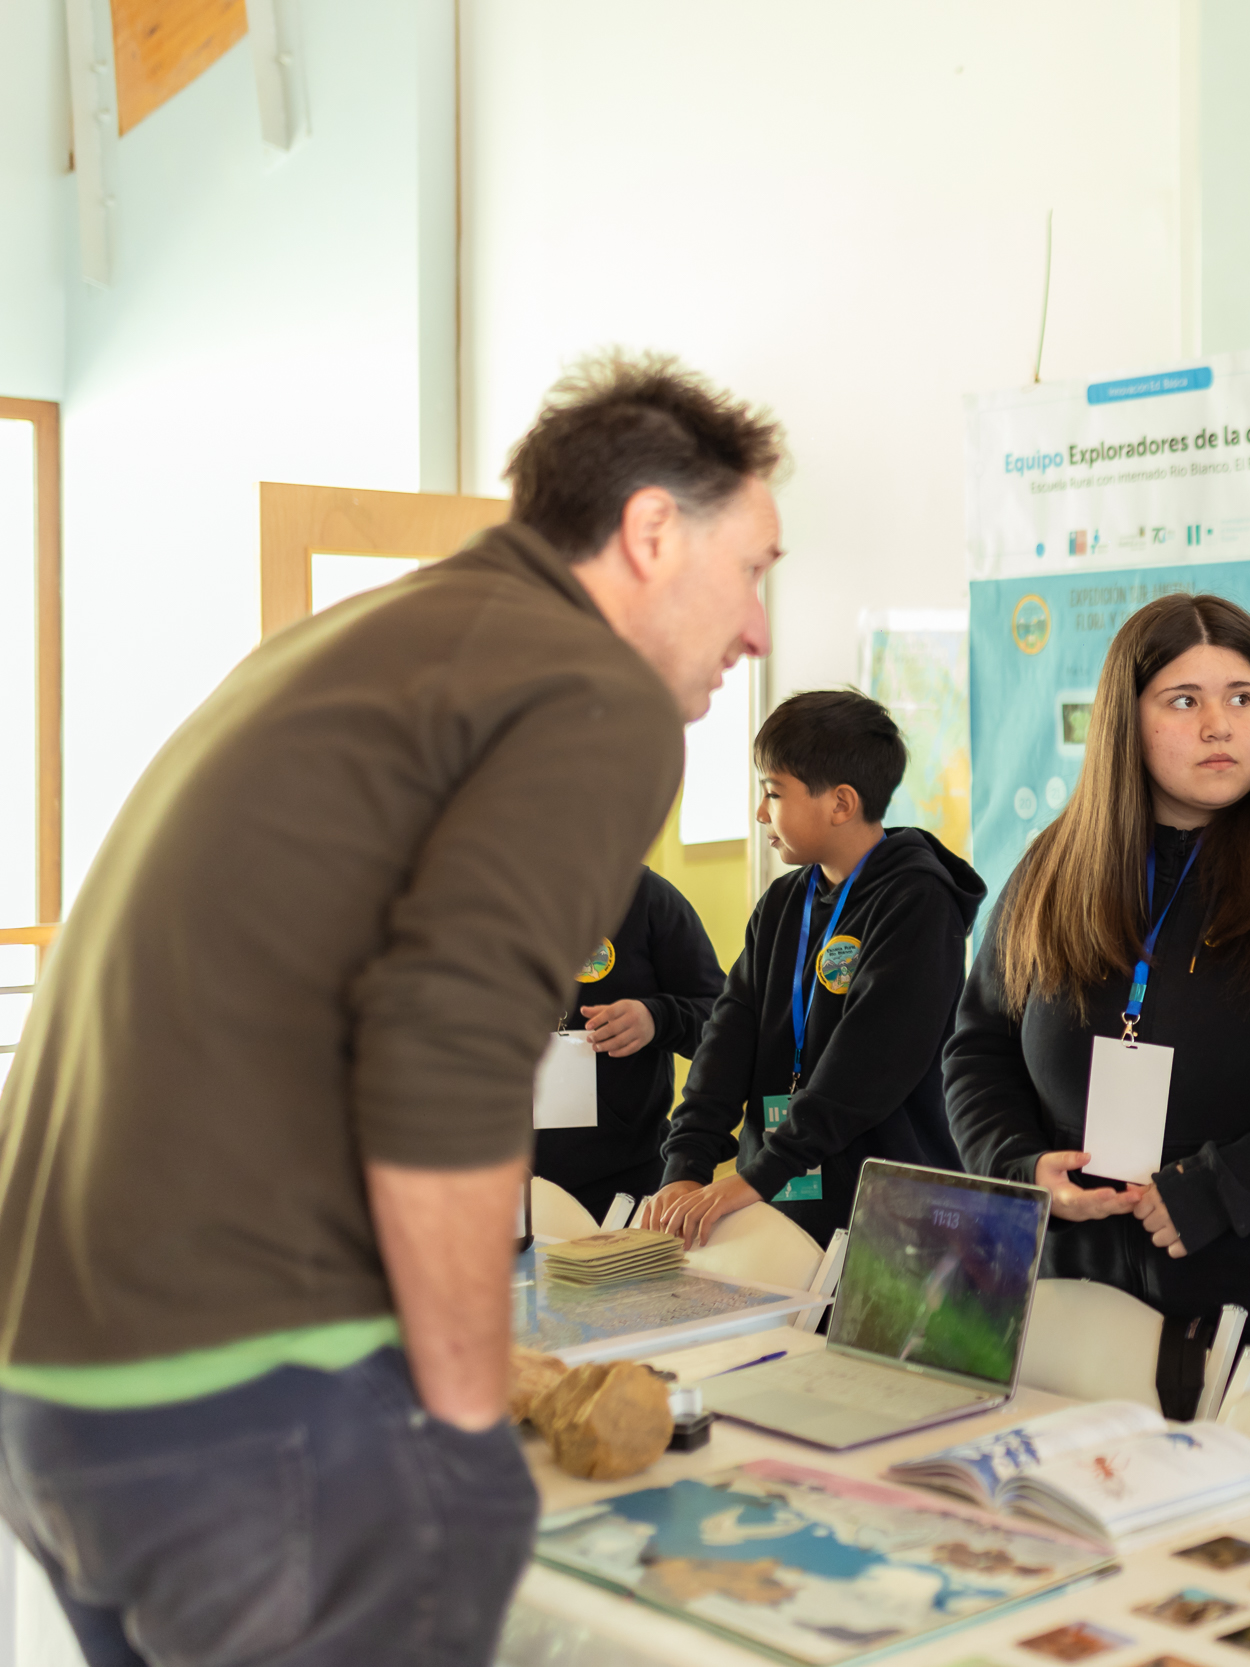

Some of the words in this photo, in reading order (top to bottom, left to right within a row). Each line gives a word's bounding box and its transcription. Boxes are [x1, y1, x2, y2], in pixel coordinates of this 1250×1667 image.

[1005, 452, 1063, 476] Equipo
[1068, 434, 1189, 467] Exploradores
[1194, 428, 1217, 450] de
[1224, 426, 1239, 446] la
[933, 1209, 960, 1230] 11:13
